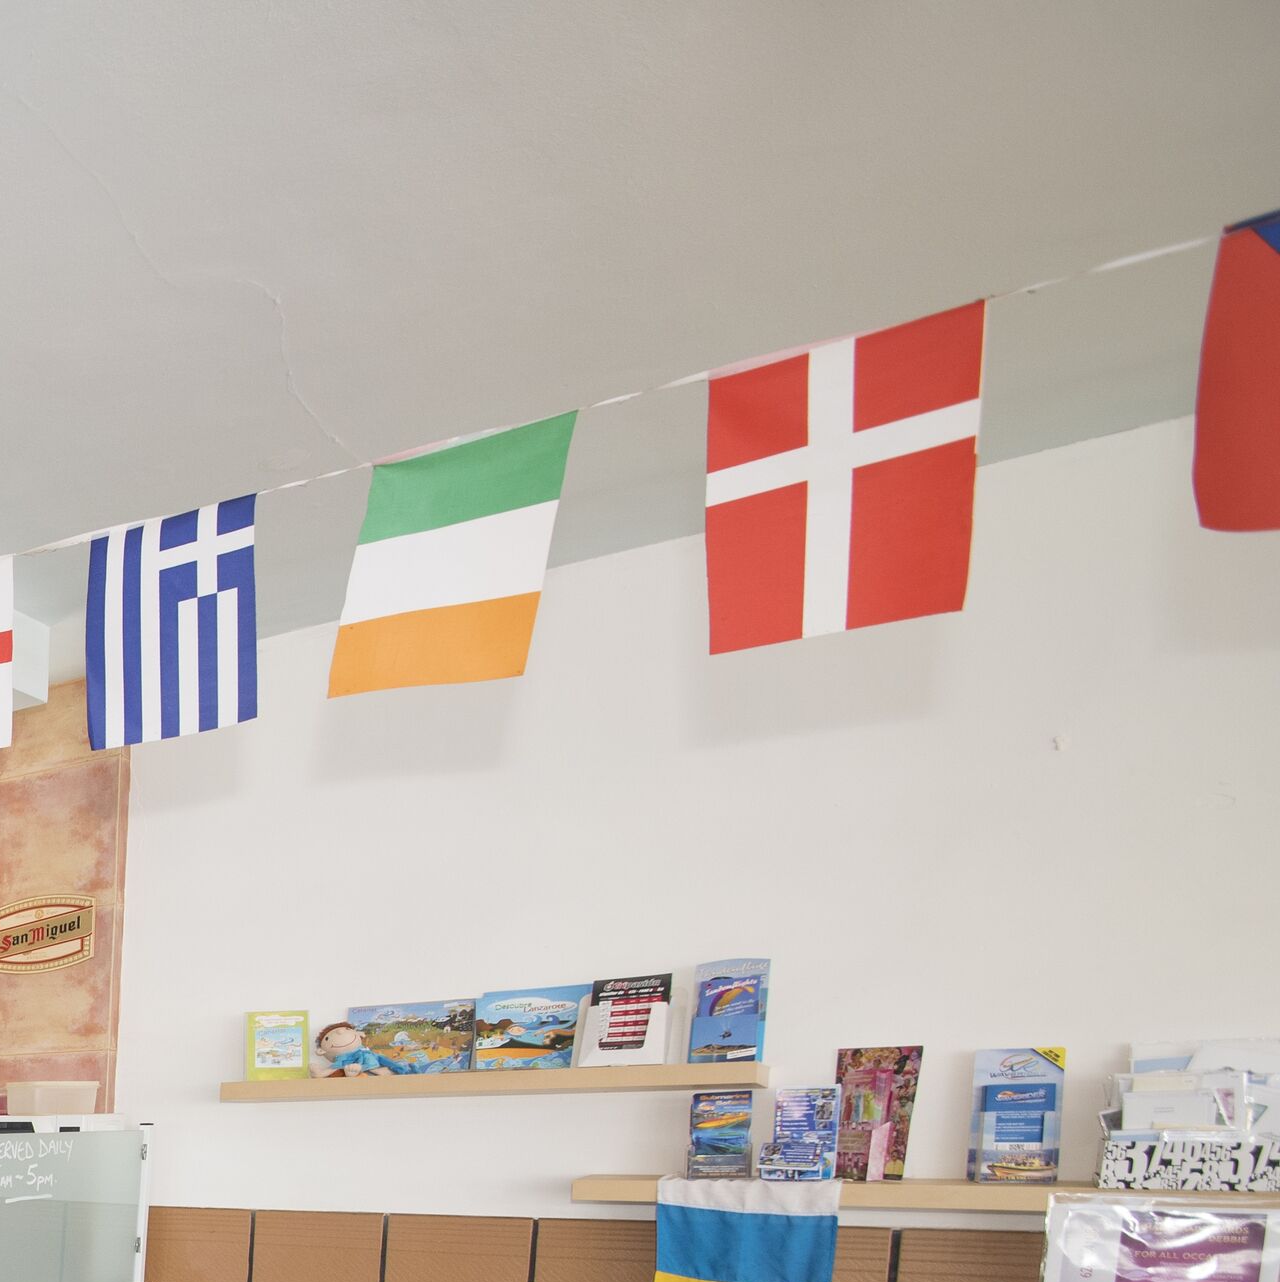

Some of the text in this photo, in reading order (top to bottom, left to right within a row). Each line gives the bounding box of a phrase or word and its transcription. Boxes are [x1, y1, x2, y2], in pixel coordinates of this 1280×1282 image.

[28, 916, 81, 946] Miguel
[523, 1001, 567, 1014] Lanzarote
[39, 1138, 74, 1162] DAILY
[1209, 1234, 1249, 1244] DEBBIE
[1135, 1250, 1180, 1260] FOR ALL
